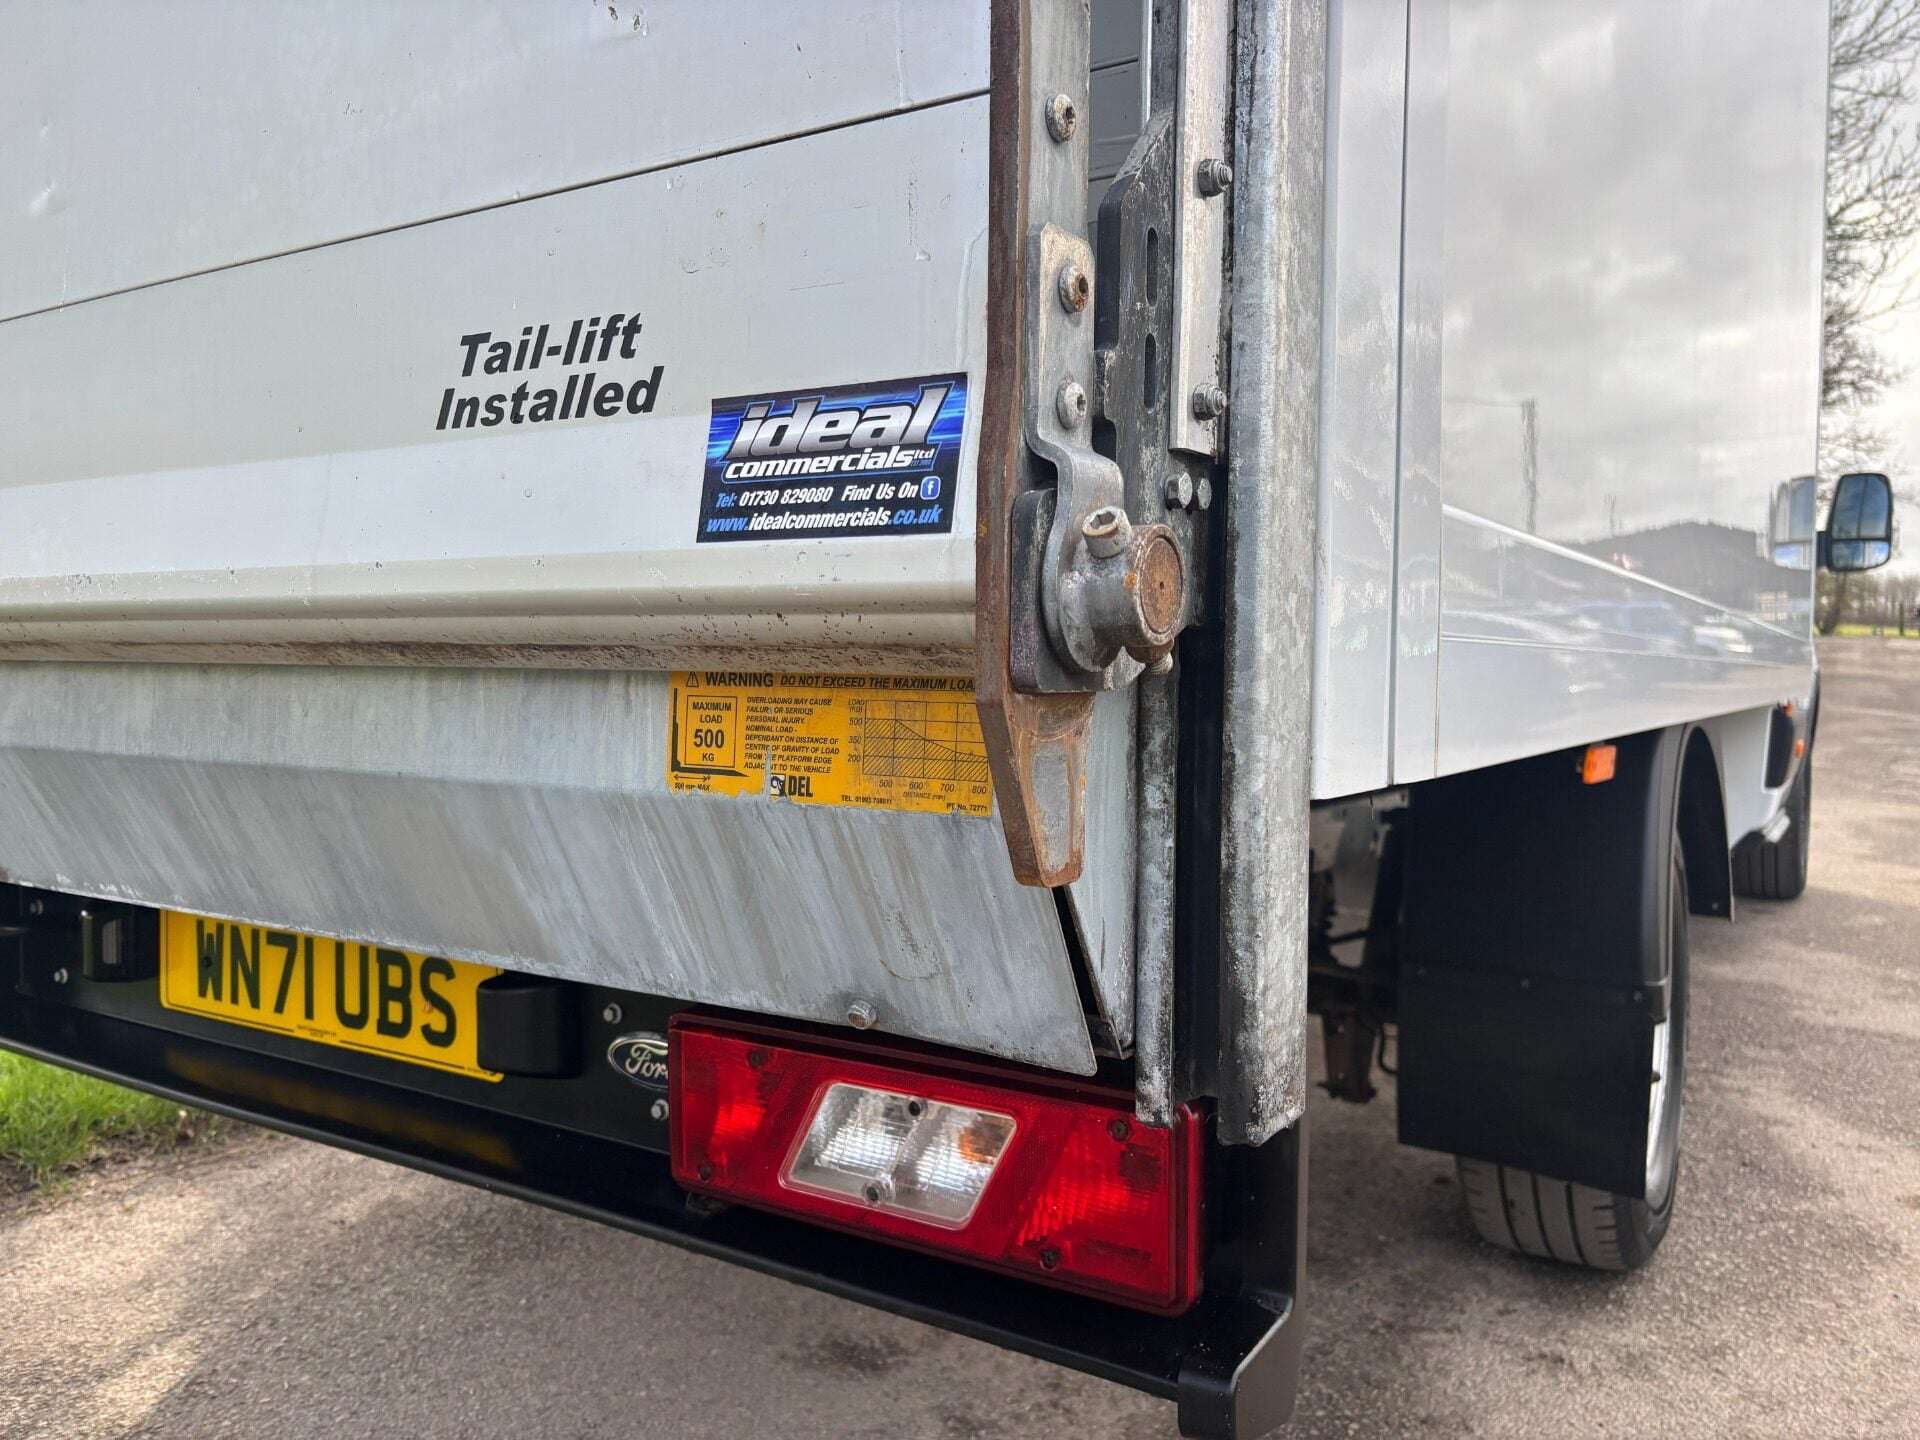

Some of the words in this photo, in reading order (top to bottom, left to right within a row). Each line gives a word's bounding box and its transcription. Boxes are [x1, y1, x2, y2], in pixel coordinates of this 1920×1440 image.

[460, 312, 643, 377] Tail-lift
[436, 366, 665, 430] Installed
[726, 384, 951, 459] ideal
[725, 446, 914, 479] commercials
[715, 493, 737, 508] Tel:
[739, 490, 779, 507] 01730
[780, 486, 834, 504] 829080
[841, 484, 875, 502] Find
[876, 482, 894, 500] Us
[898, 481, 919, 498] On
[707, 504, 943, 532] www.idealcommercials.co.uk
[705, 672, 774, 687] WARNING
[780, 675, 795, 686] DO
[798, 676, 820, 687] NOT
[823, 676, 865, 688] EXCEED
[869, 677, 890, 689] THE
[893, 678, 947, 690] MAXIMUM
[950, 679, 976, 691] LOA
[692, 702, 731, 712] MAXIMUM
[746, 697, 792, 705] OVERLOADING
[809, 698, 832, 706] CAUSE
[785, 707, 814, 716] SERIOUS
[700, 714, 723, 724] LOAD
[746, 716, 778, 724] PERSONAL
[746, 725, 773, 733] NOMINAL
[694, 729, 725, 749] 500
[785, 735, 796, 743] ON
[796, 736, 828, 745] DISTANCE
[772, 744, 780, 752] OF
[782, 745, 809, 754] GRAVITY
[820, 747, 839, 755] LOAD
[702, 752, 715, 762] KG
[744, 752, 762, 760] FROM
[778, 754, 812, 763] PLATFORM
[814, 756, 832, 764] EDGE
[790, 764, 801, 772] THE
[803, 765, 831, 773] VEHICLE
[789, 775, 813, 797] DEL
[940, 784, 955, 792] 700
[972, 786, 987, 794] 800
[196, 919, 314, 1020] WN71
[335, 940, 457, 1048] UBS
[625, 1043, 668, 1079] For
